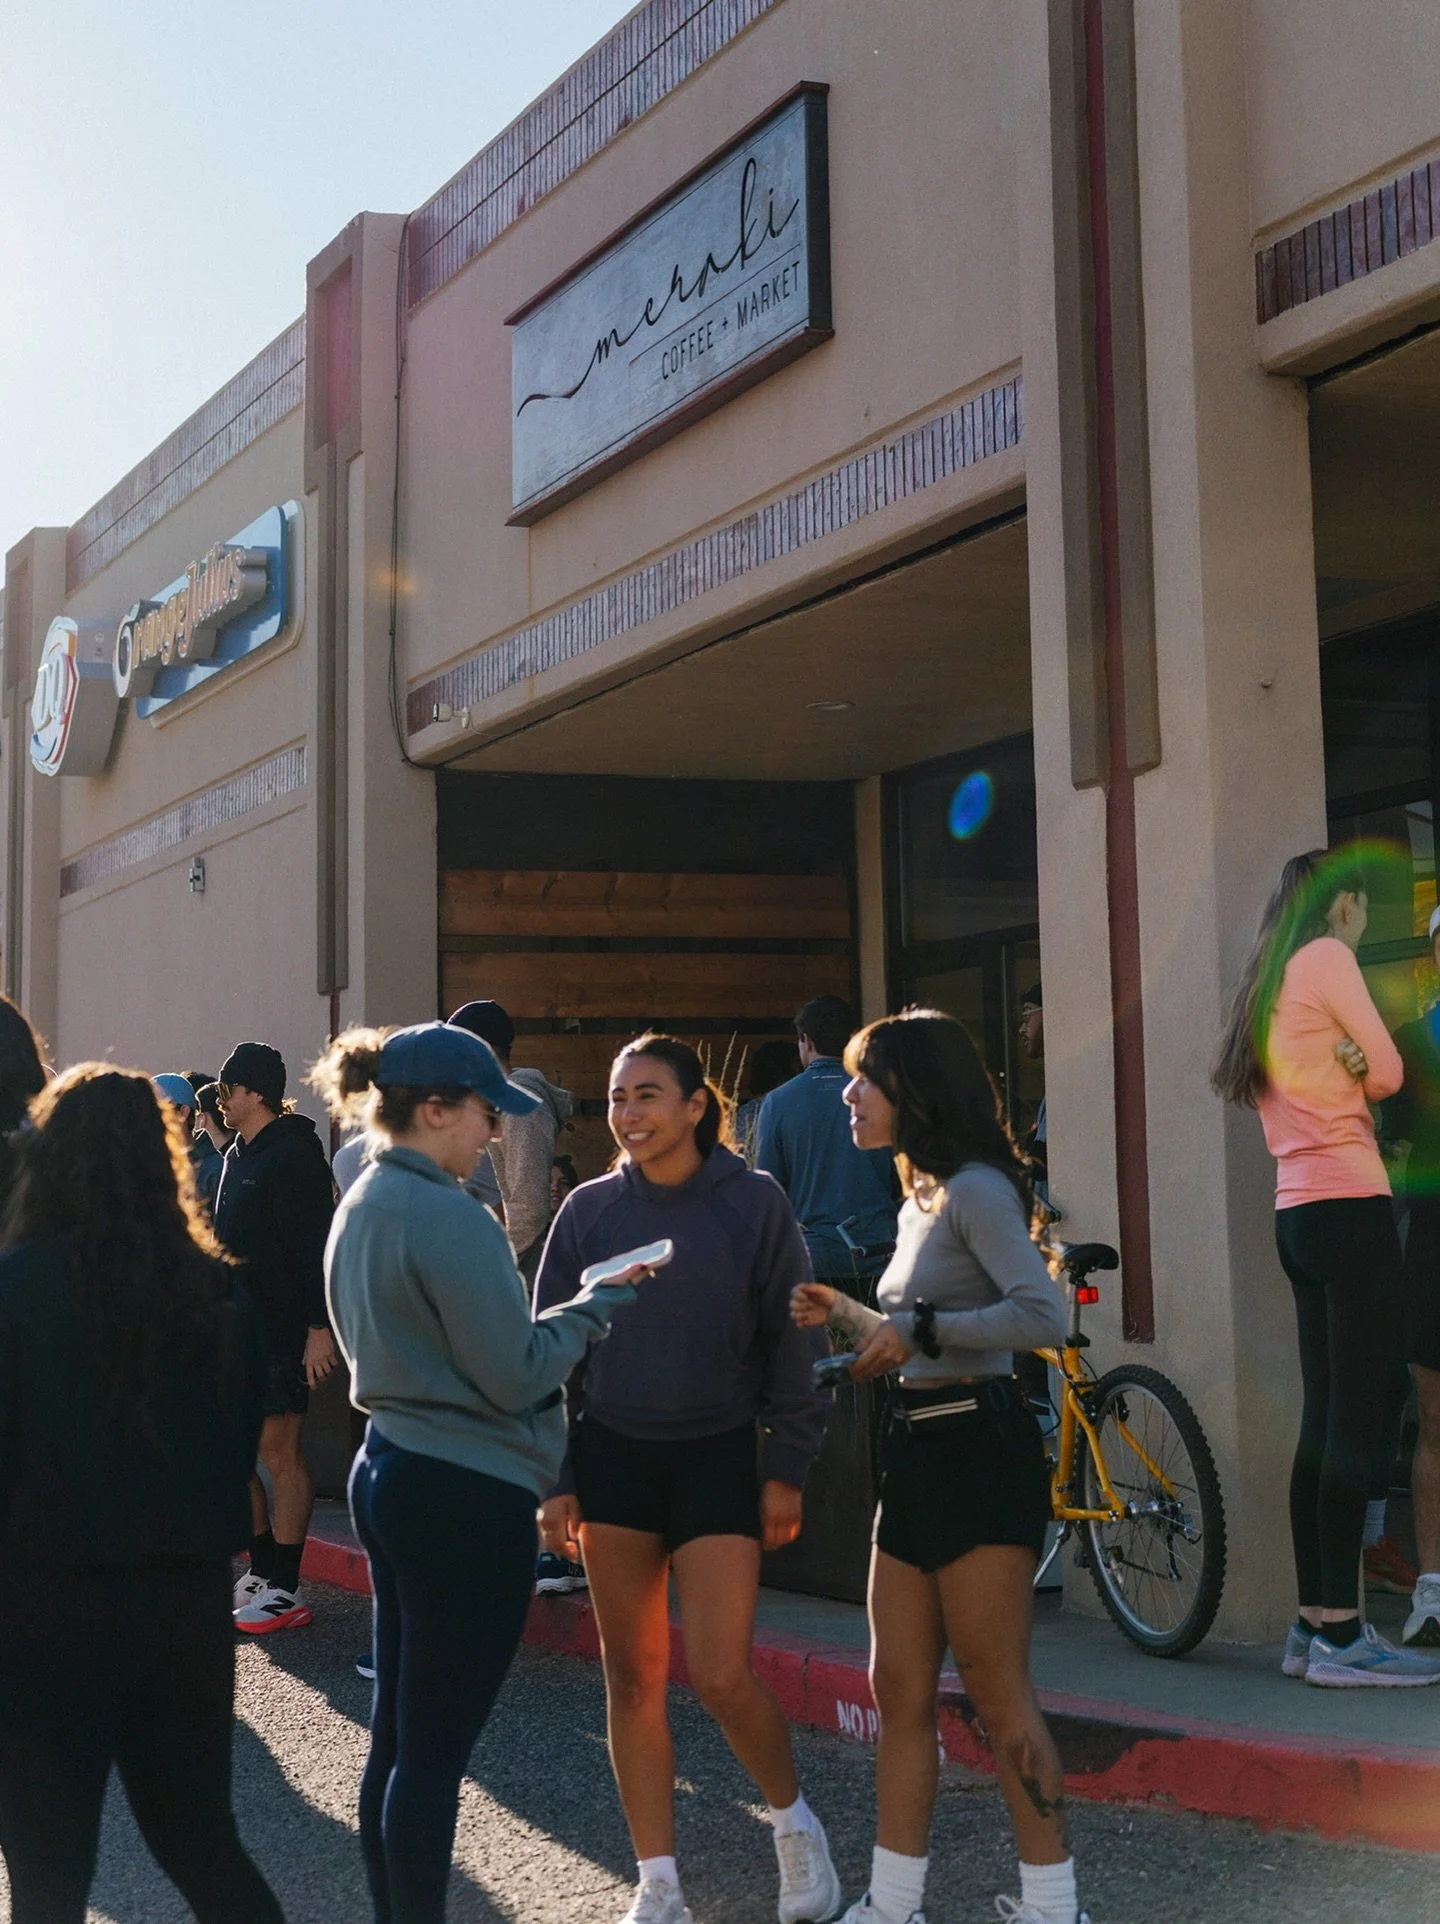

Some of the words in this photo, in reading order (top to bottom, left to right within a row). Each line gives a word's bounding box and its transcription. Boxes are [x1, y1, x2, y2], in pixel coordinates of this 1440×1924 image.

[516, 157, 800, 417] meraki
[661, 320, 714, 380] COFFEE
[737, 260, 800, 330] MARKET
[836, 1699, 864, 1740] NO
